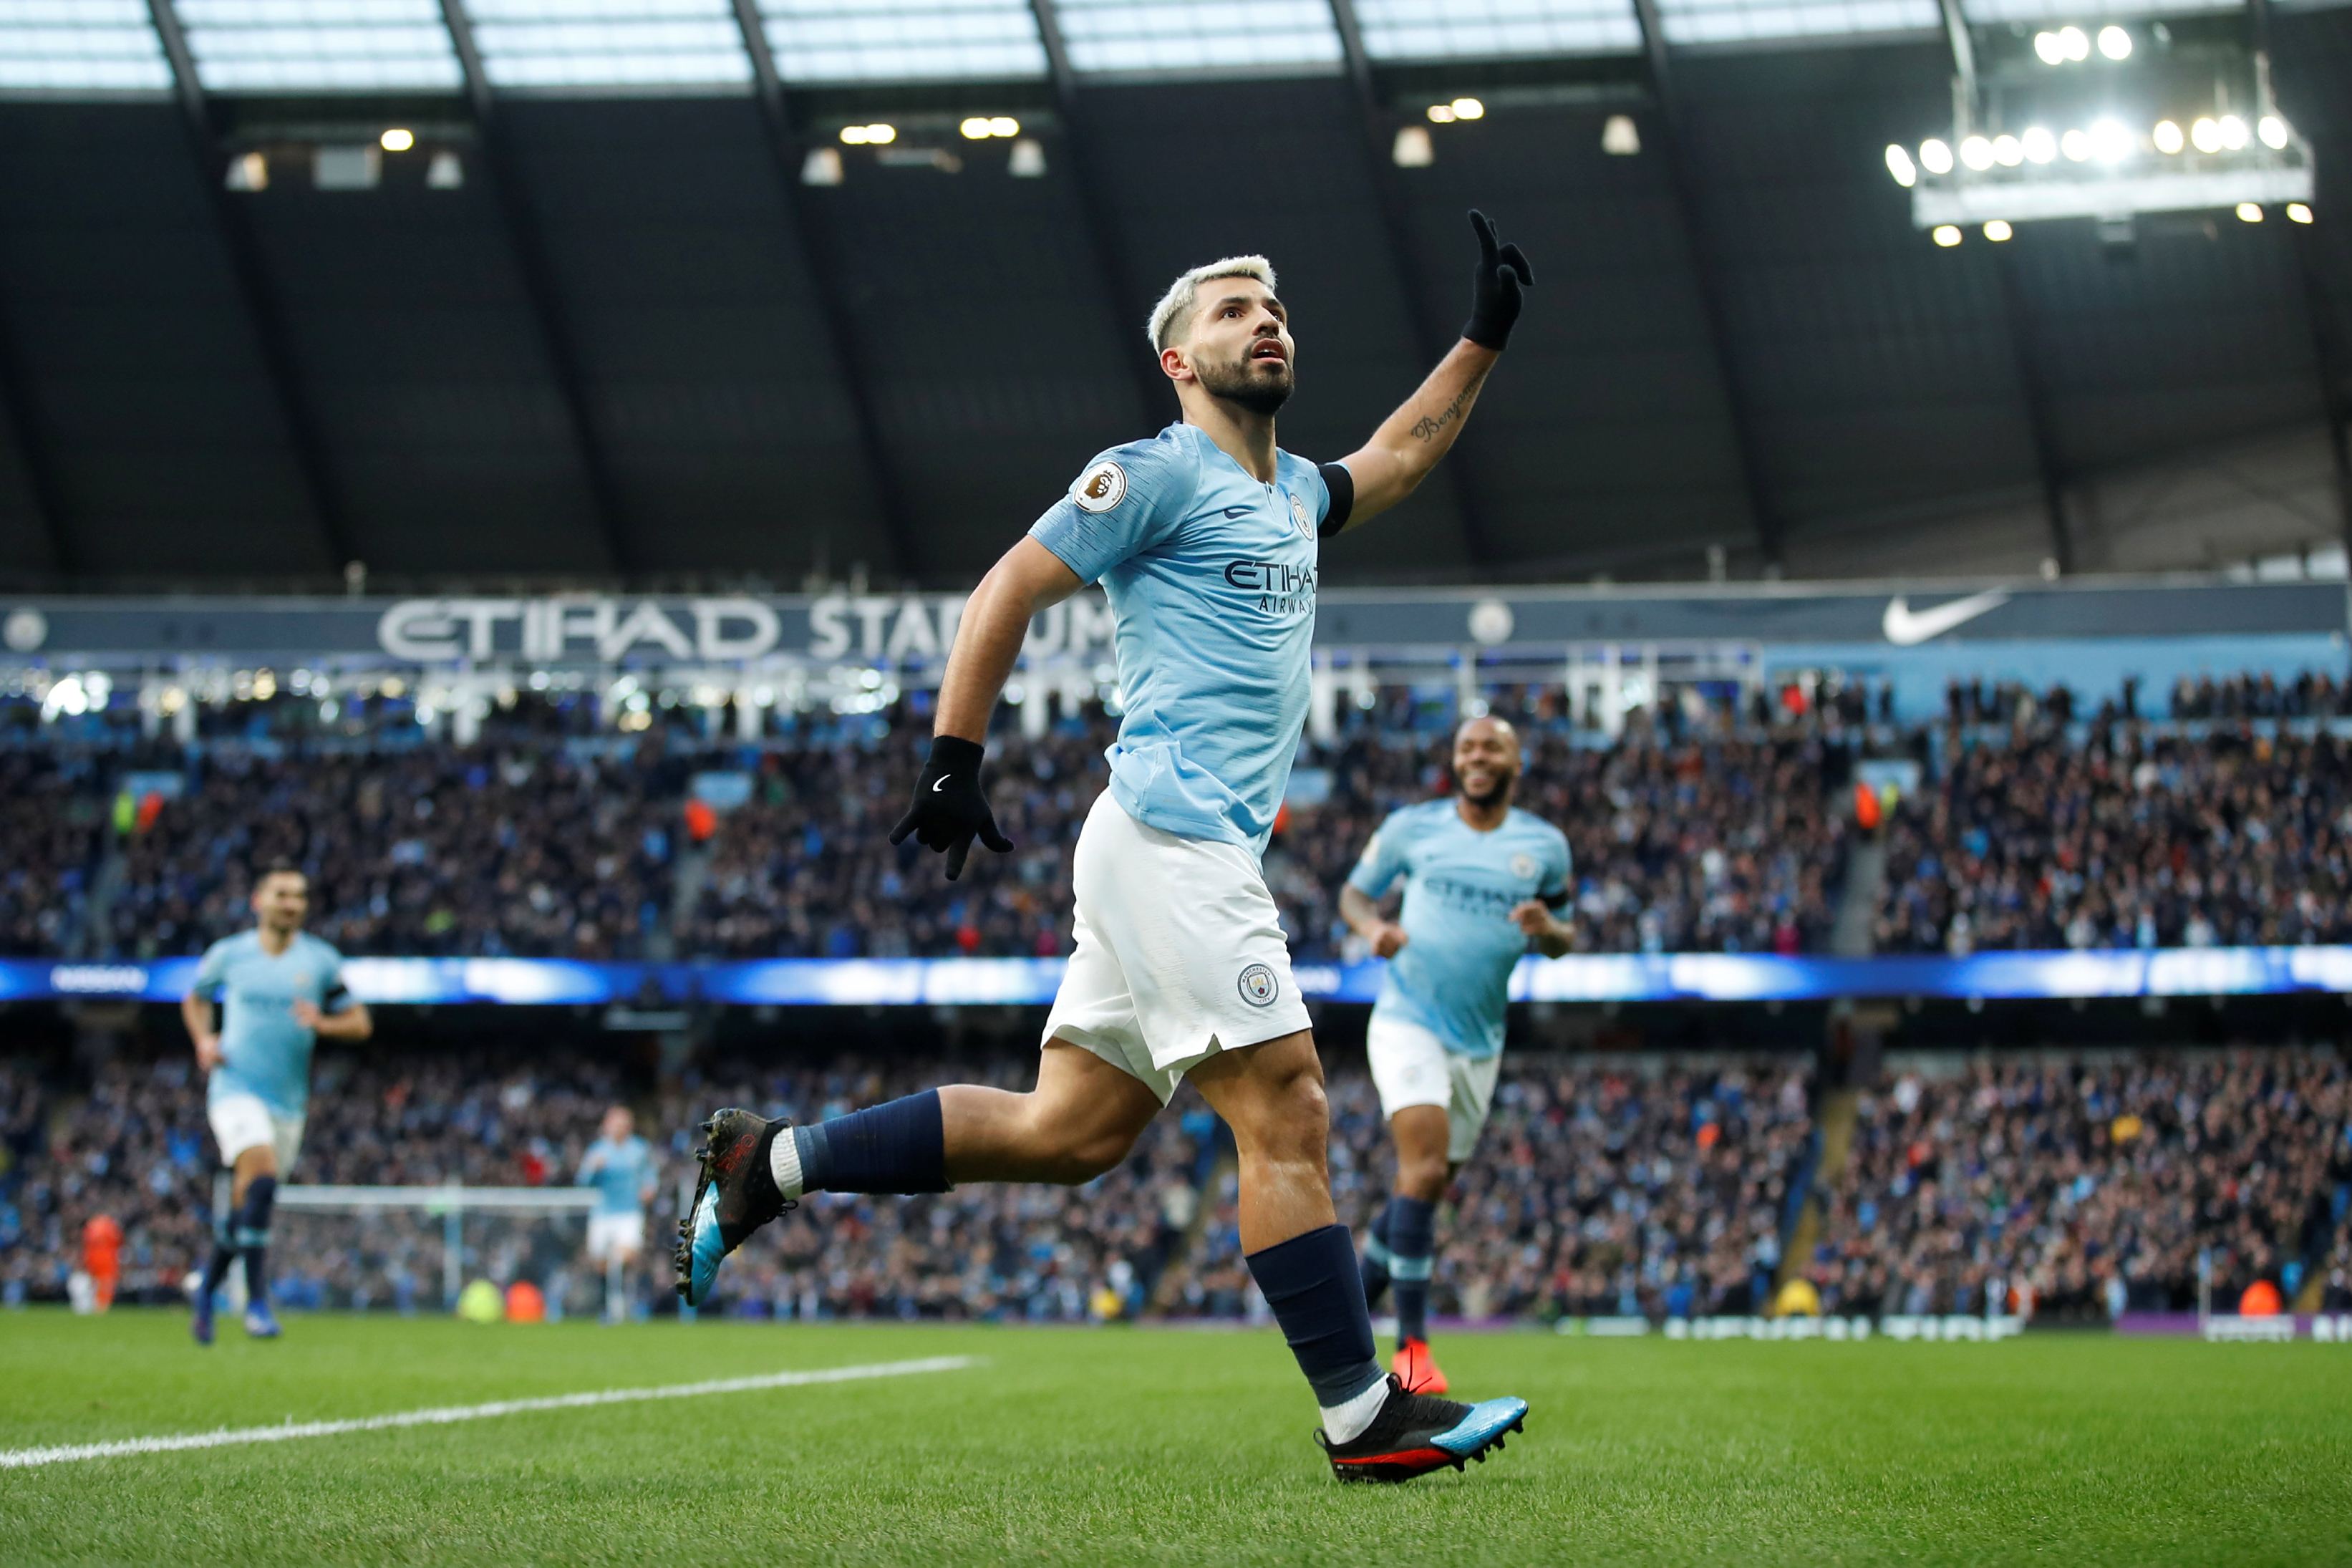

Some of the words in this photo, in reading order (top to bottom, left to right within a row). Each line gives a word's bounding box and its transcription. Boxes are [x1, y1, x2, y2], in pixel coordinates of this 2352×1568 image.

[1410, 369, 1486, 443] Benjam
[1224, 561, 1317, 594] ETIHA
[377, 599, 783, 662] ETIHAD
[809, 595, 1116, 660] STAUM
